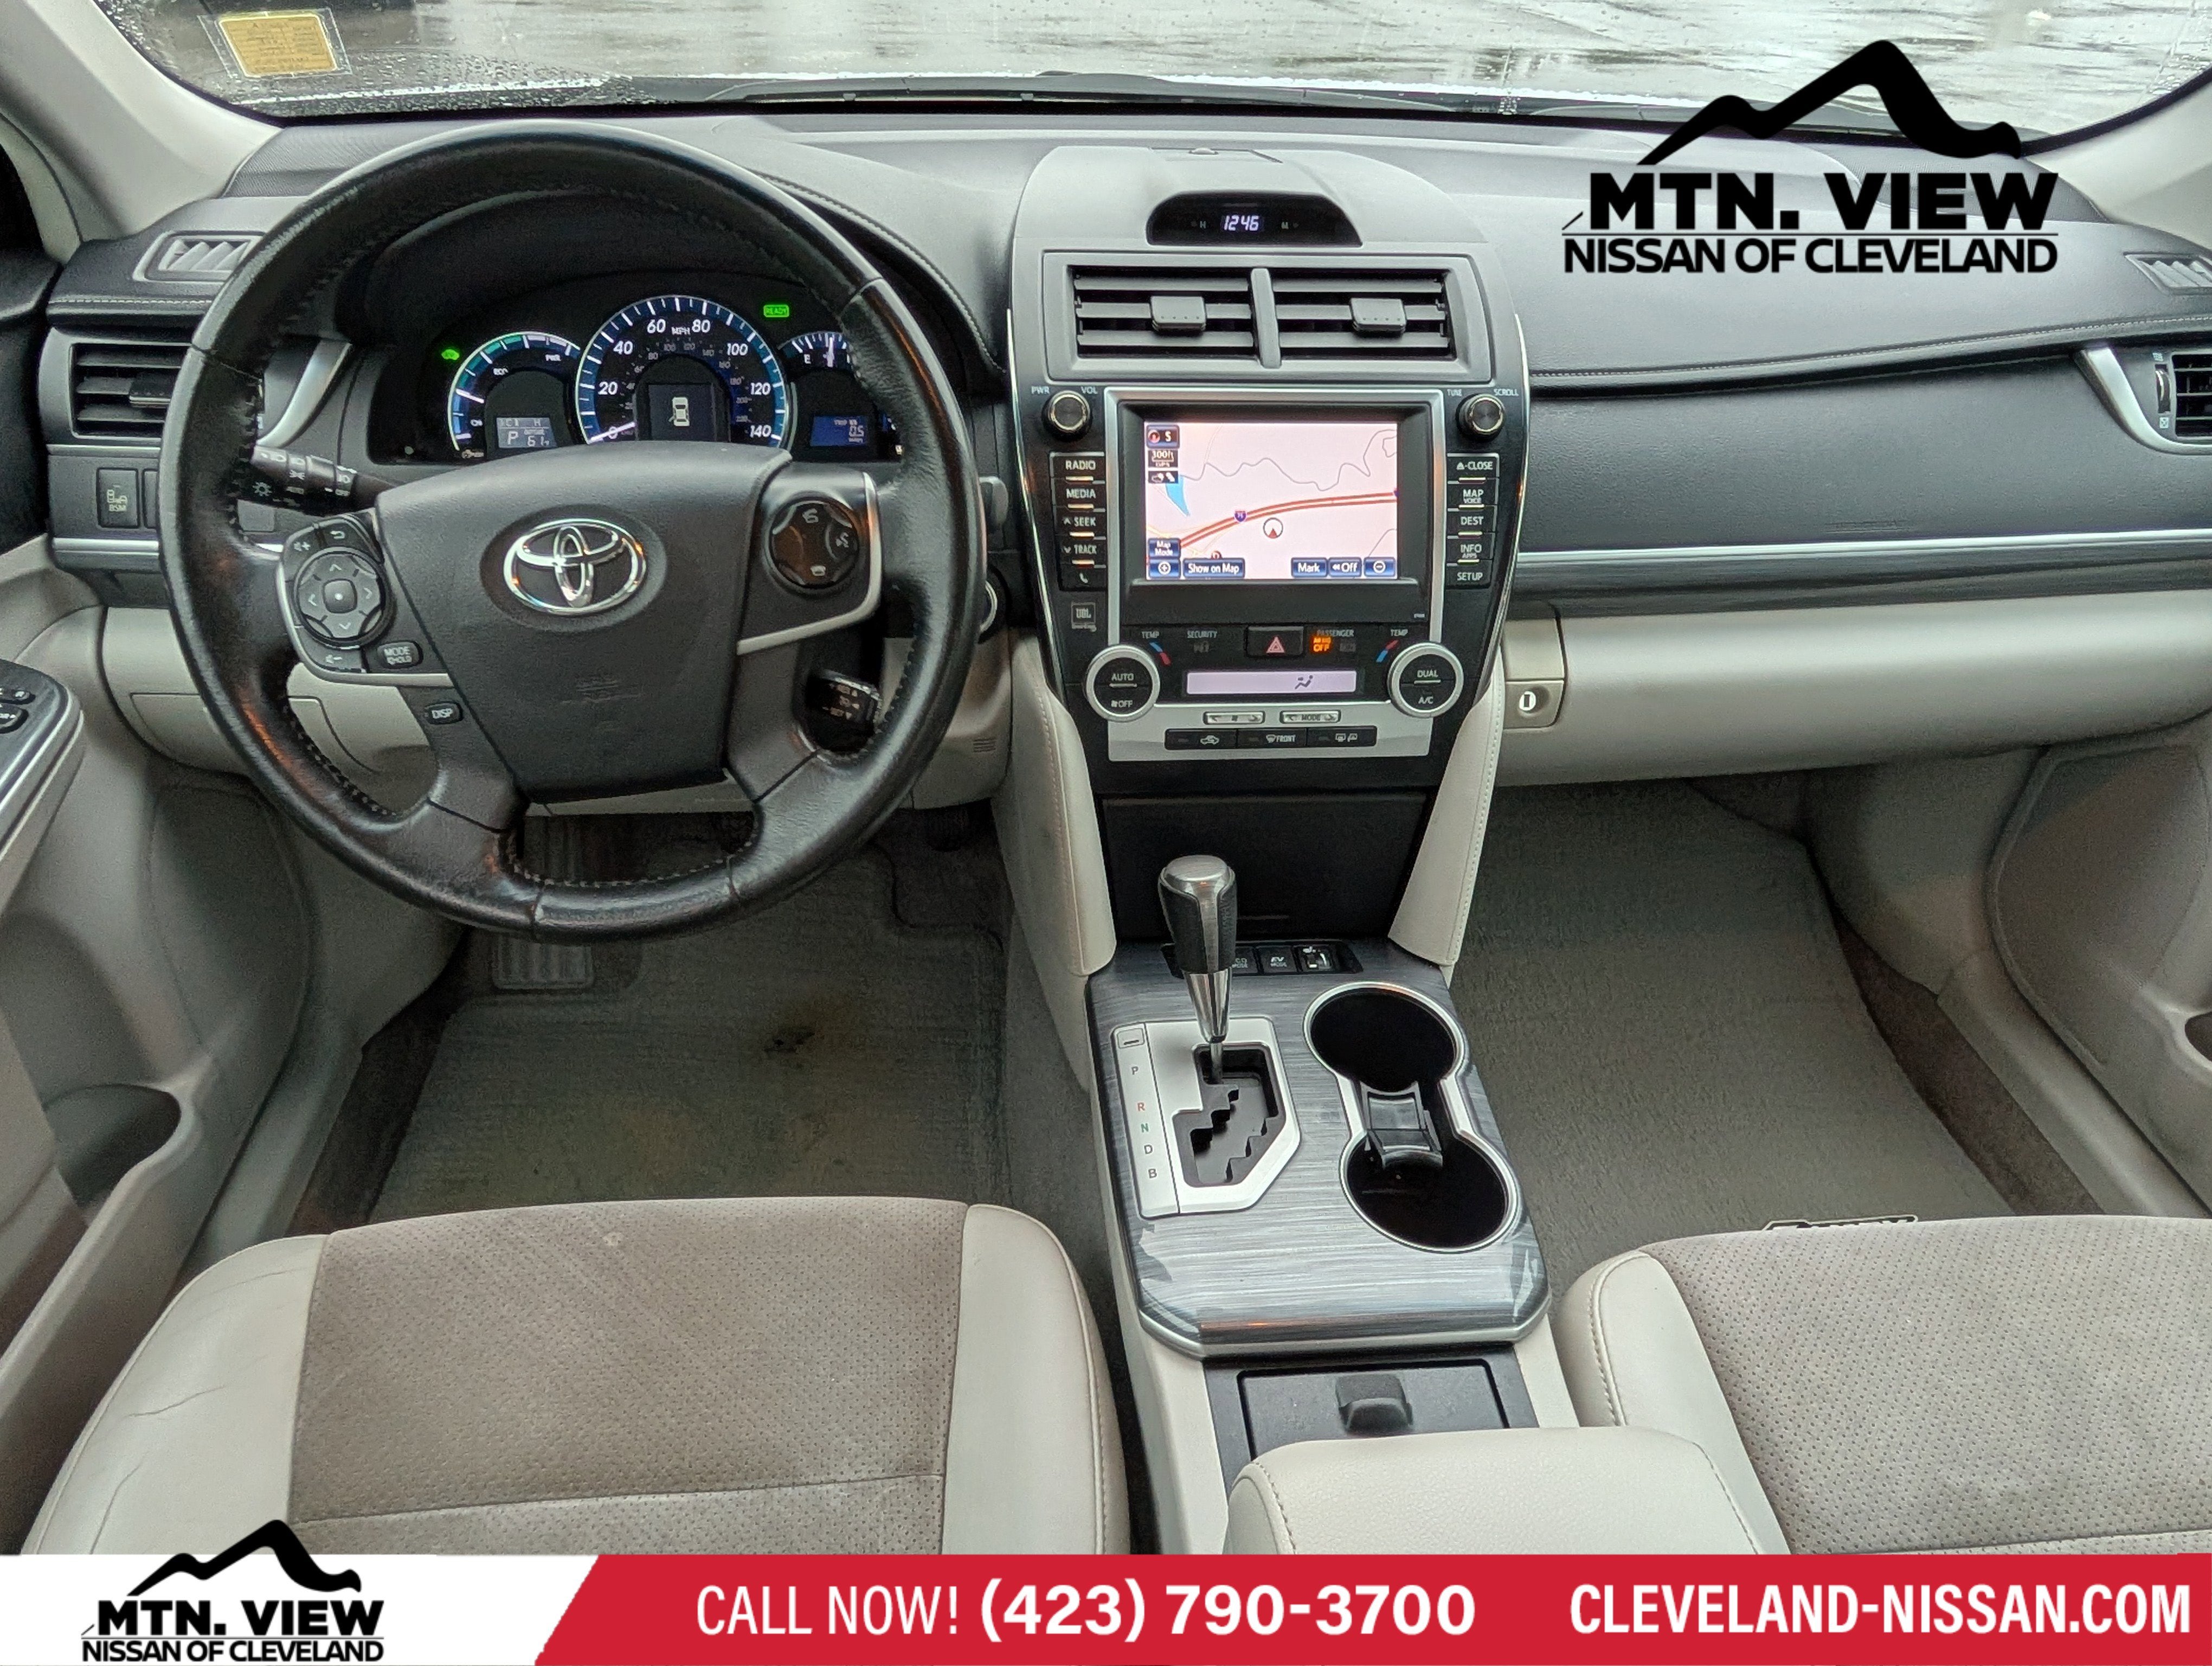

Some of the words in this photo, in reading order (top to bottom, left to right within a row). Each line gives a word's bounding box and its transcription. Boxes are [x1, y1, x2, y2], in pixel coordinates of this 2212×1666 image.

[647, 319, 666, 334] 60
[692, 319, 710, 333] 80
[613, 341, 633, 355] 40
[726, 343, 748, 356] 100
[597, 381, 618, 395] 20
[750, 382, 771, 395] 120
[1031, 386, 1050, 394] PWR
[1081, 386, 1098, 394] VOL
[749, 425, 771, 438] 140
[1165, 431, 1172, 442] S
[1065, 460, 1096, 470] RADIO
[1066, 489, 1096, 499] MEDIA
[1463, 489, 1484, 498] MAP
[1074, 517, 1096, 527] SEEK
[1461, 517, 1484, 526] DEST
[1074, 544, 1097, 554] TRACK
[1460, 544, 1482, 553] INFO
[1188, 563, 1209, 573] Show
[1222, 563, 1239, 575] Map
[1297, 562, 1320, 573] Mark
[1341, 562, 1358, 573] Off
[1457, 572, 1483, 581] SETUP
[1141, 631, 1160, 639] TEMP
[1187, 630, 1218, 639] SECURITY
[1316, 629, 1354, 637] PASSENGER
[1390, 629, 1408, 637] TEMP
[383, 646, 410, 657] MODE
[1111, 672, 1134, 681] AUTO
[1417, 669, 1439, 678] DUAL
[1118, 700, 1133, 708] OFF
[1418, 696, 1434, 704] A/C
[432, 708, 453, 719] DISP
[1275, 734, 1296, 742] FRONT
[1131, 1066, 1139, 1075] P
[1137, 1102, 1146, 1111] R
[1141, 1123, 1149, 1133] N
[1144, 1144, 1153, 1155] D
[1148, 1168, 1158, 1179] B
